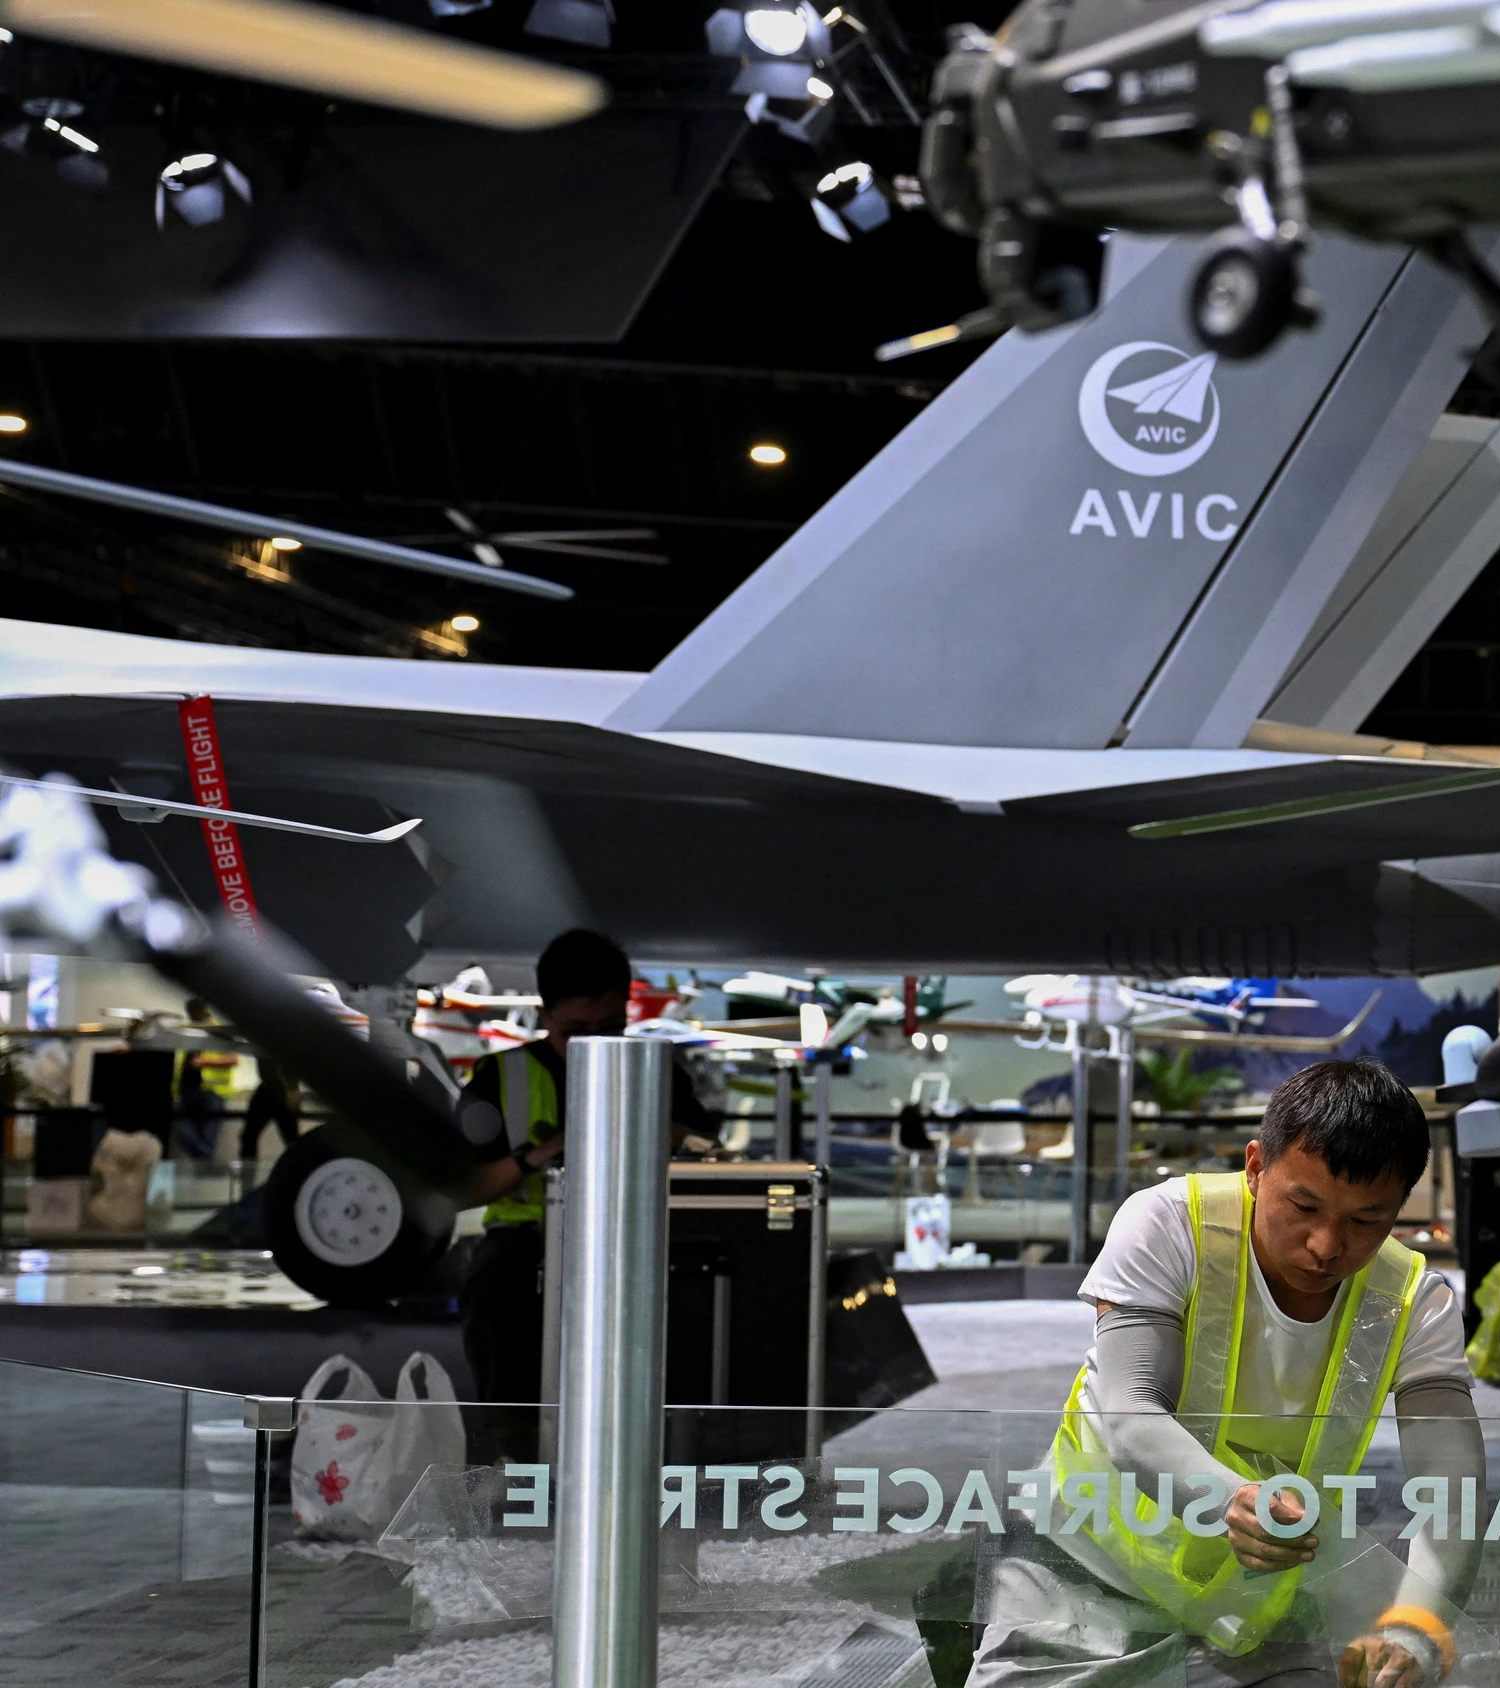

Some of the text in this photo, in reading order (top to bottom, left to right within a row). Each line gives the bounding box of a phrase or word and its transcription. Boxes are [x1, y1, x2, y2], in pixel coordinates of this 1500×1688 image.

[1134, 425, 1187, 444] AVIC
[1069, 488, 1239, 541] AVIC
[187, 716, 220, 785] FLIGHT
